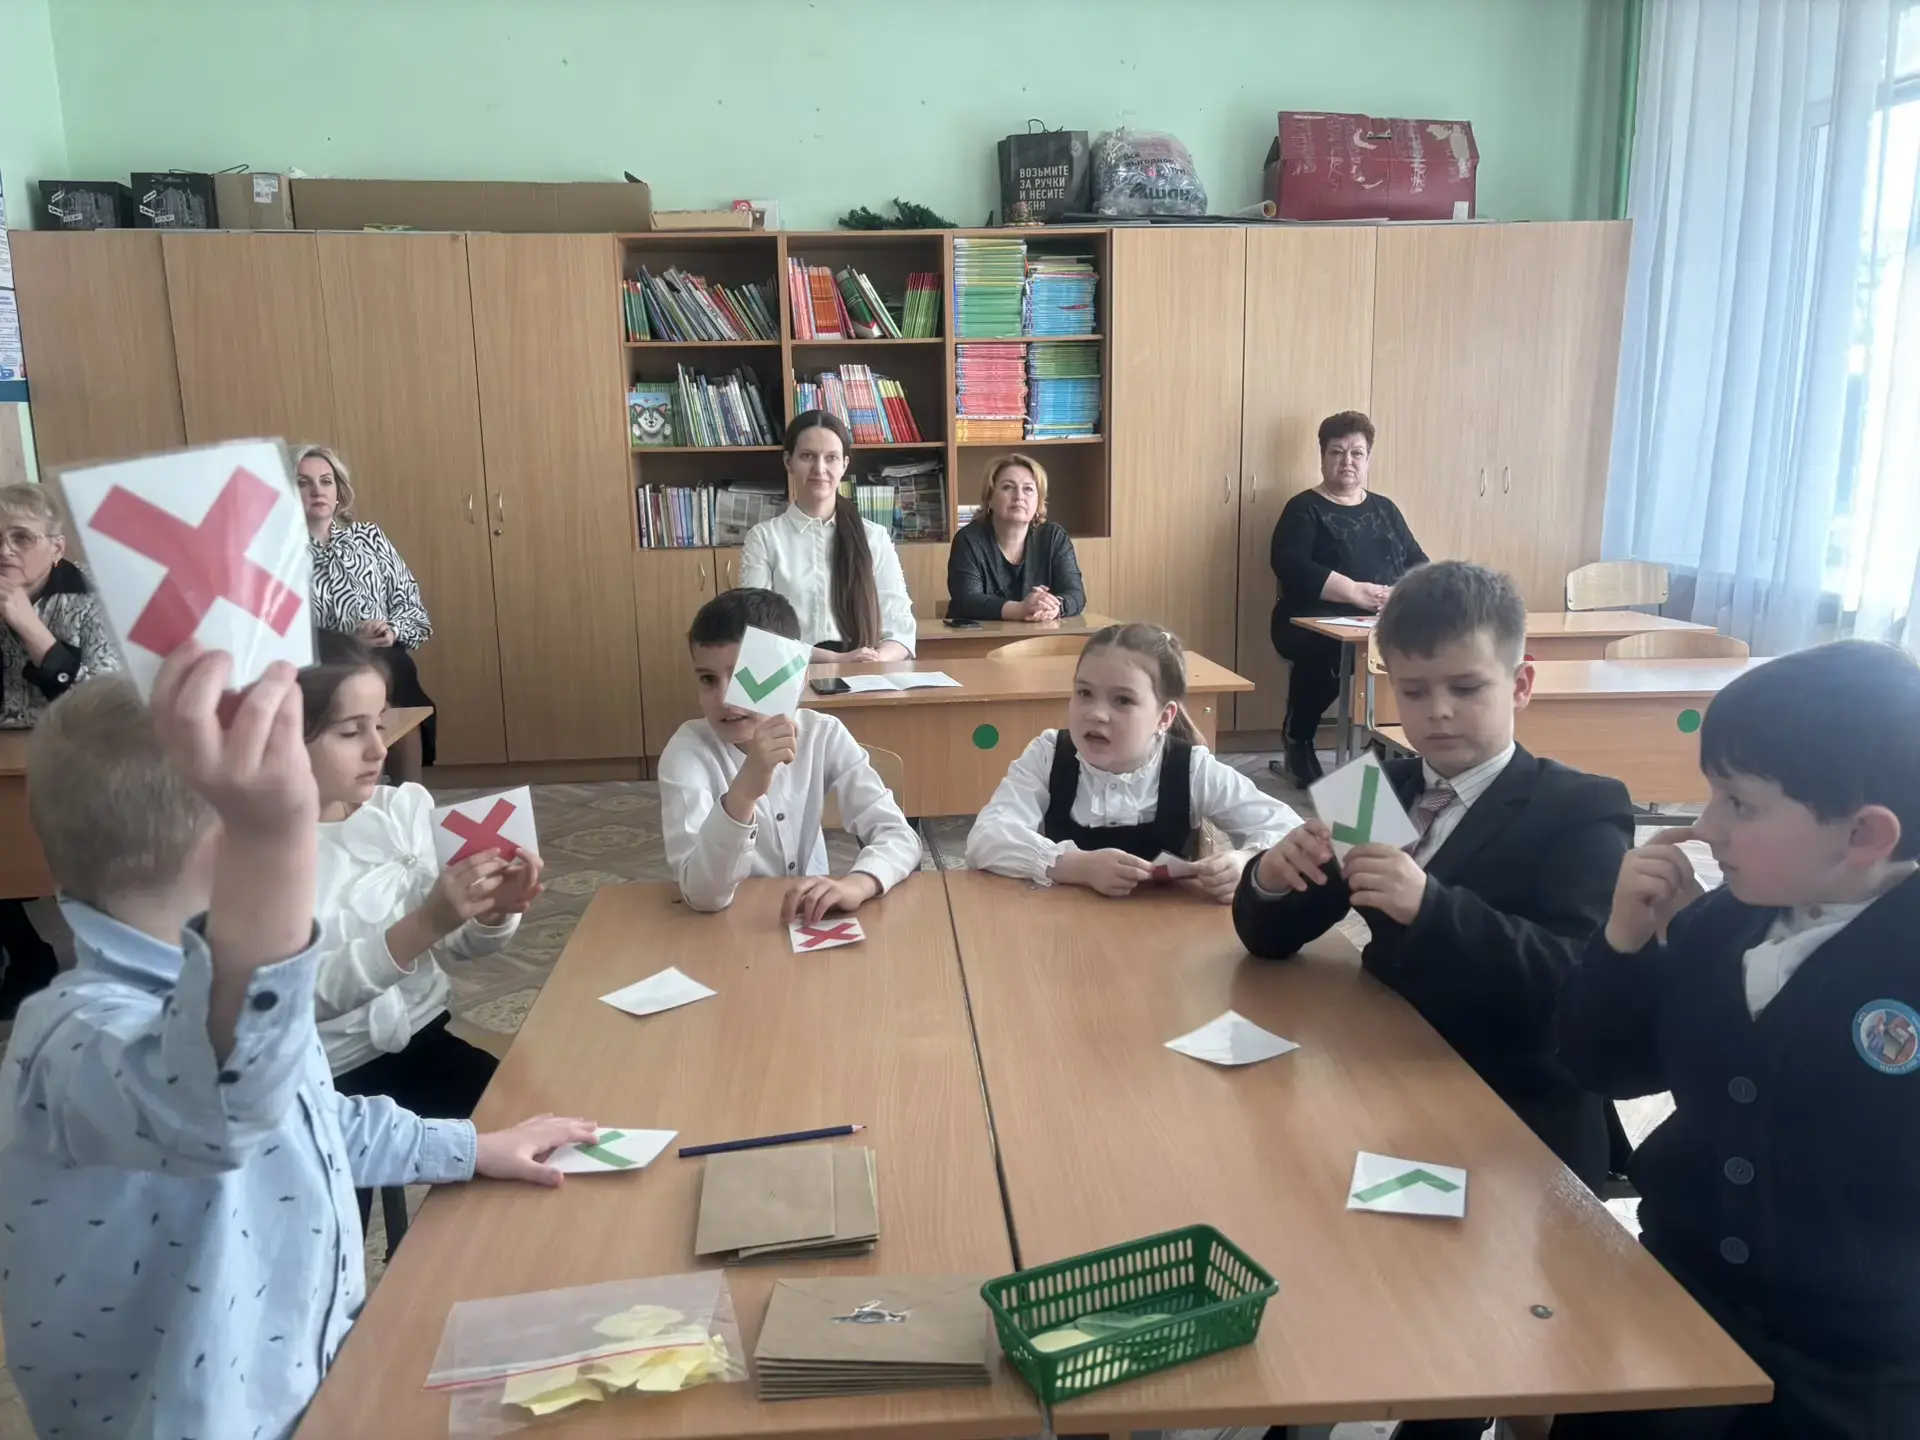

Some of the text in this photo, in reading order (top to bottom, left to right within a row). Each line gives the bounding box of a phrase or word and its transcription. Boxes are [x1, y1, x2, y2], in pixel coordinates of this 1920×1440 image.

[1020, 165, 1069, 178] ВОЗЬМИТЕ
[1020, 177, 1065, 189] ЗА РУЧКИ
[1020, 188, 1065, 200] И НЕСИТЕ
[1023, 200, 1046, 211] ЕНЯ
